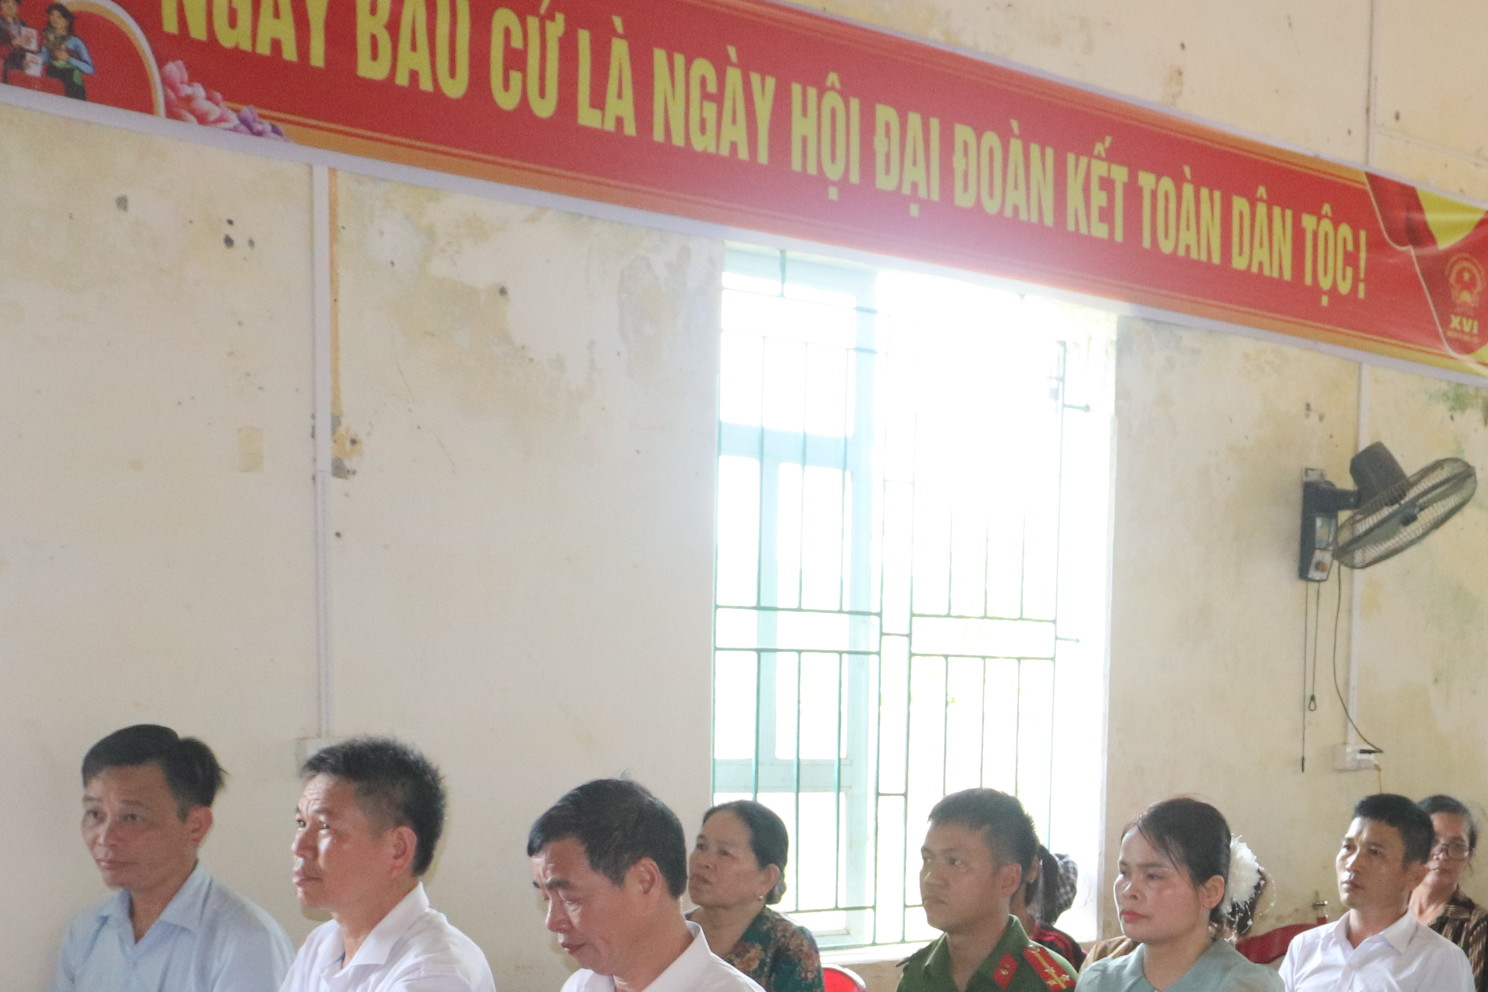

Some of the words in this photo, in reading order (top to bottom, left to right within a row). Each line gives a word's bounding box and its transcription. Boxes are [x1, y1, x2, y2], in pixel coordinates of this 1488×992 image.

[577, 15, 637, 137] LÀ
[652, 45, 776, 165] NGÀY
[791, 73, 860, 200] HỘI
[874, 103, 940, 217] ĐẠI
[953, 120, 1055, 227] ĐOÀN
[1065, 136, 1129, 243] KẾT
[1137, 166, 1222, 264] TOÀN
[1230, 186, 1293, 282] DÂN
[1449, 314, 1479, 335] XVI
